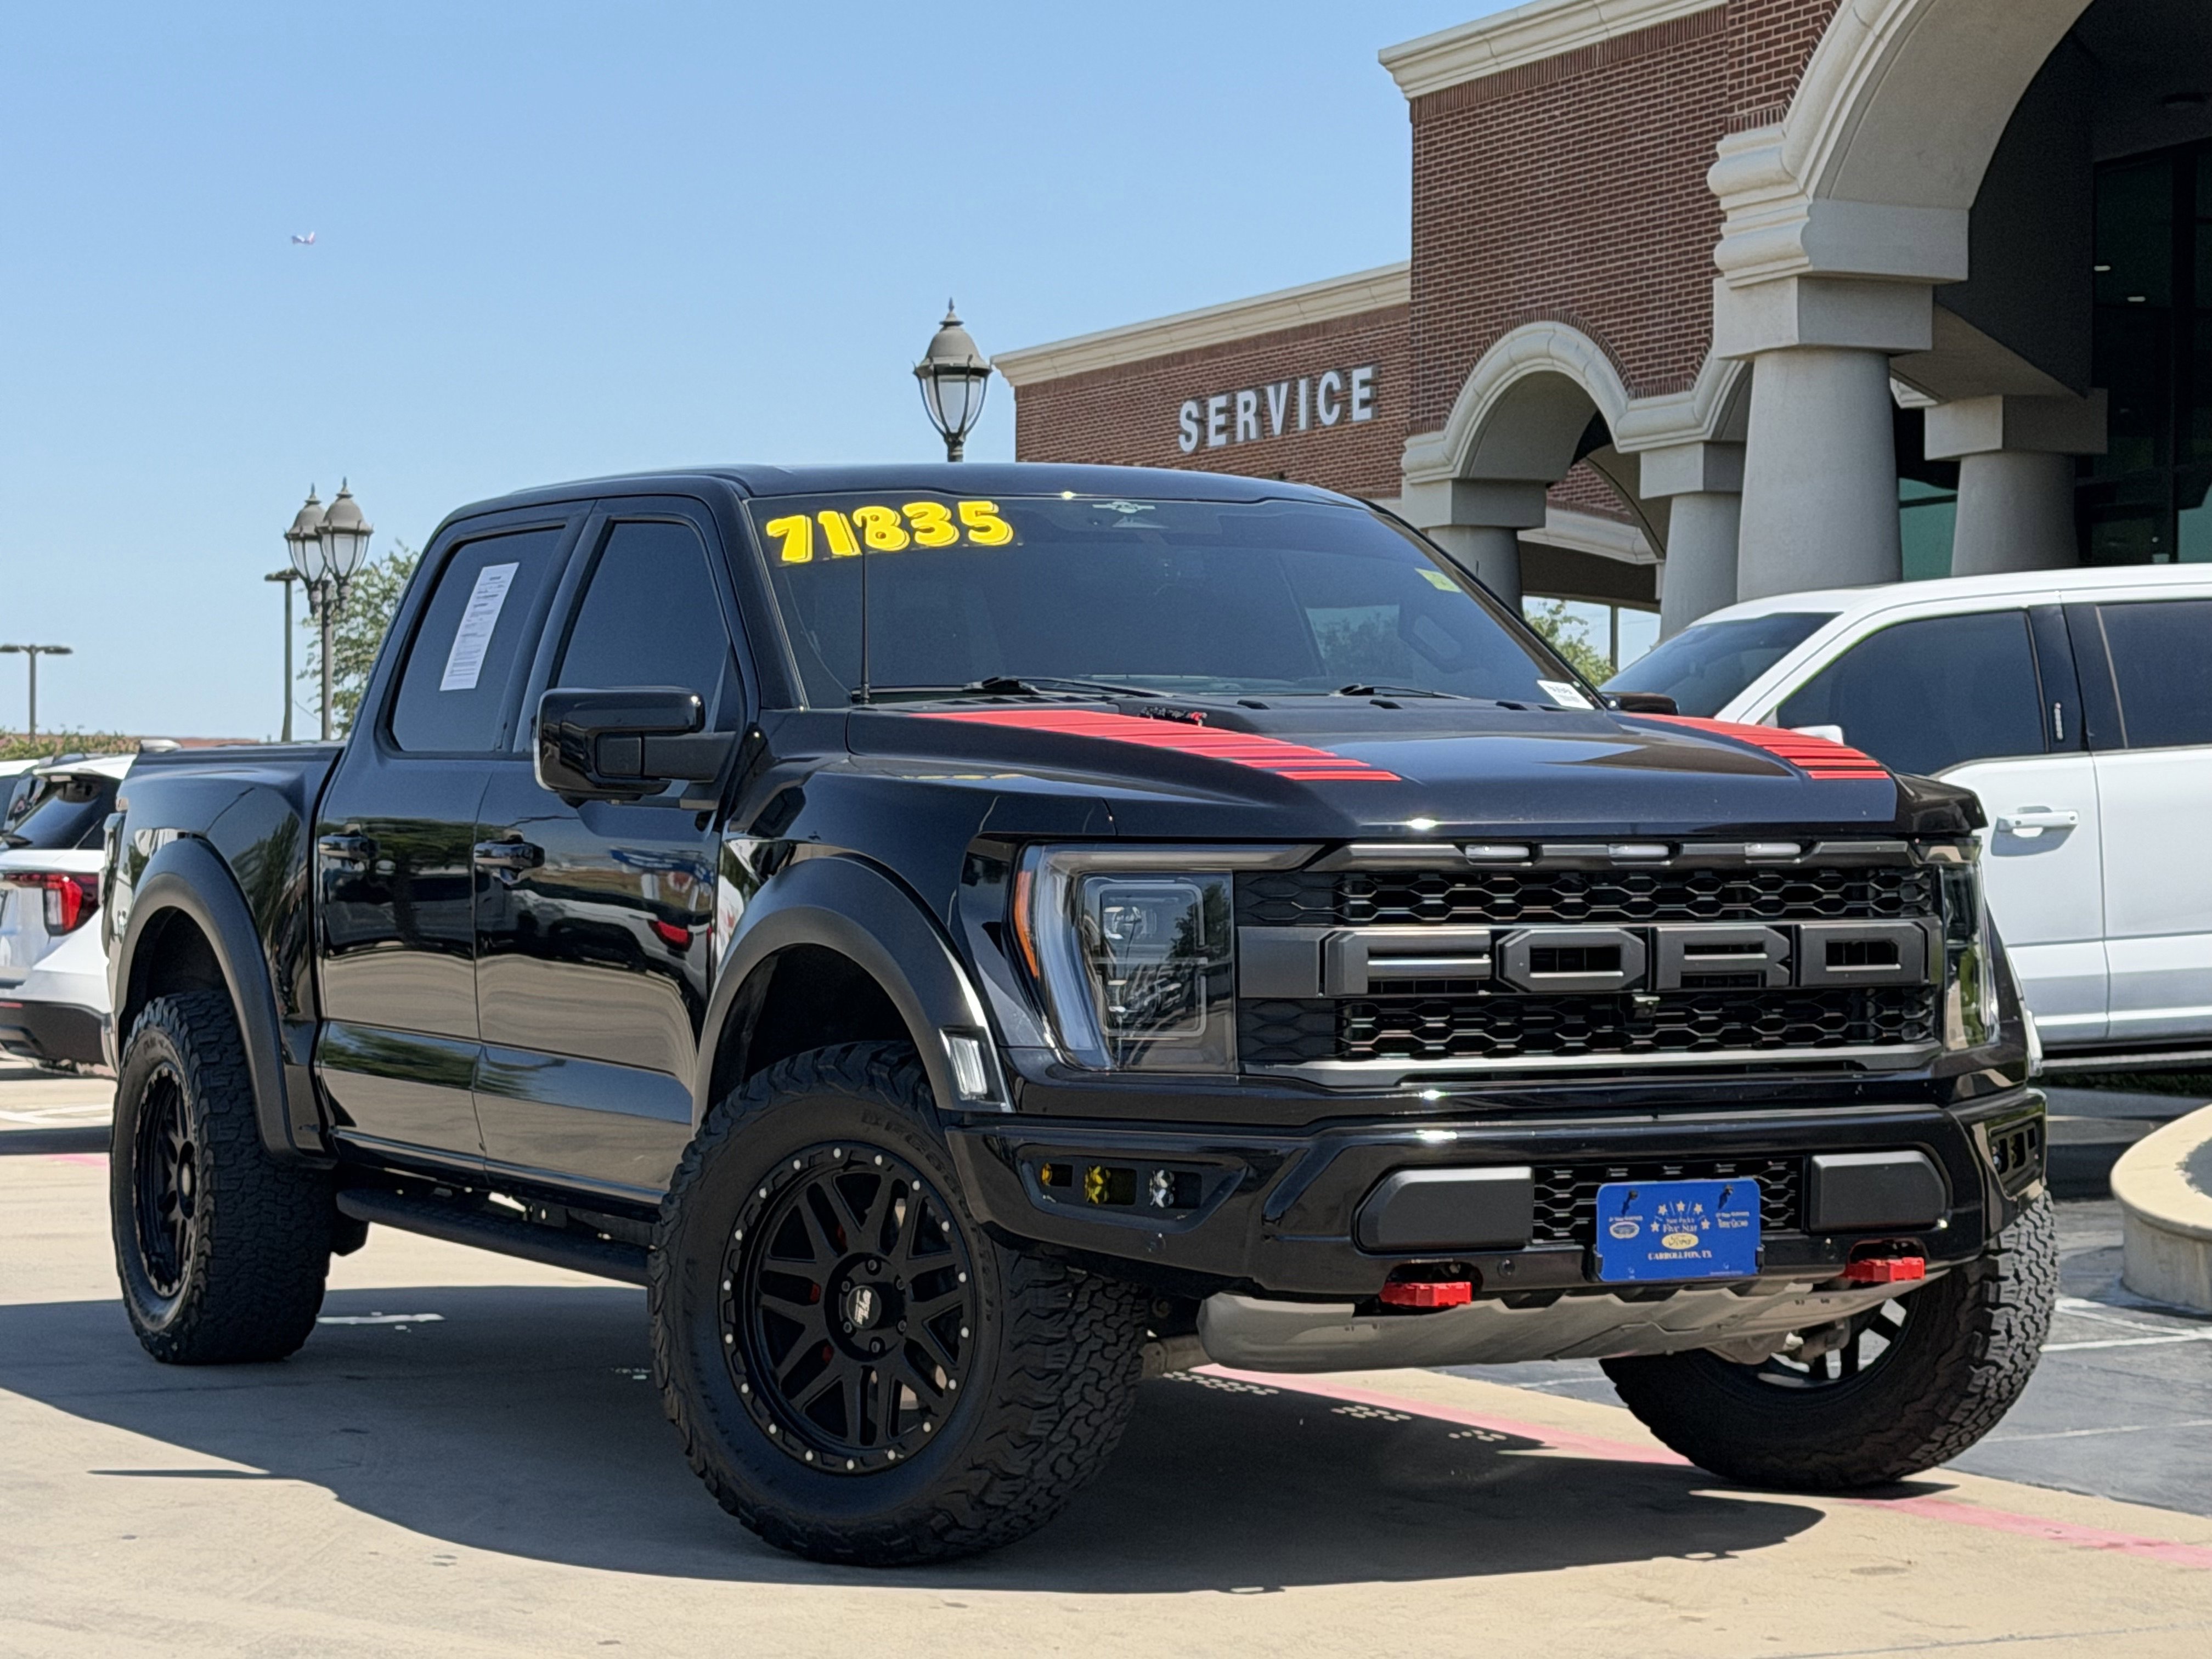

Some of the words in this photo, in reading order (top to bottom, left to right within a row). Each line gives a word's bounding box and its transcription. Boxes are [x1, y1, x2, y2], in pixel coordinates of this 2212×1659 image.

[1178, 365, 1376, 453] SERVICE
[766, 501, 1013, 563] 71835
[1325, 924, 1925, 995] FORD
